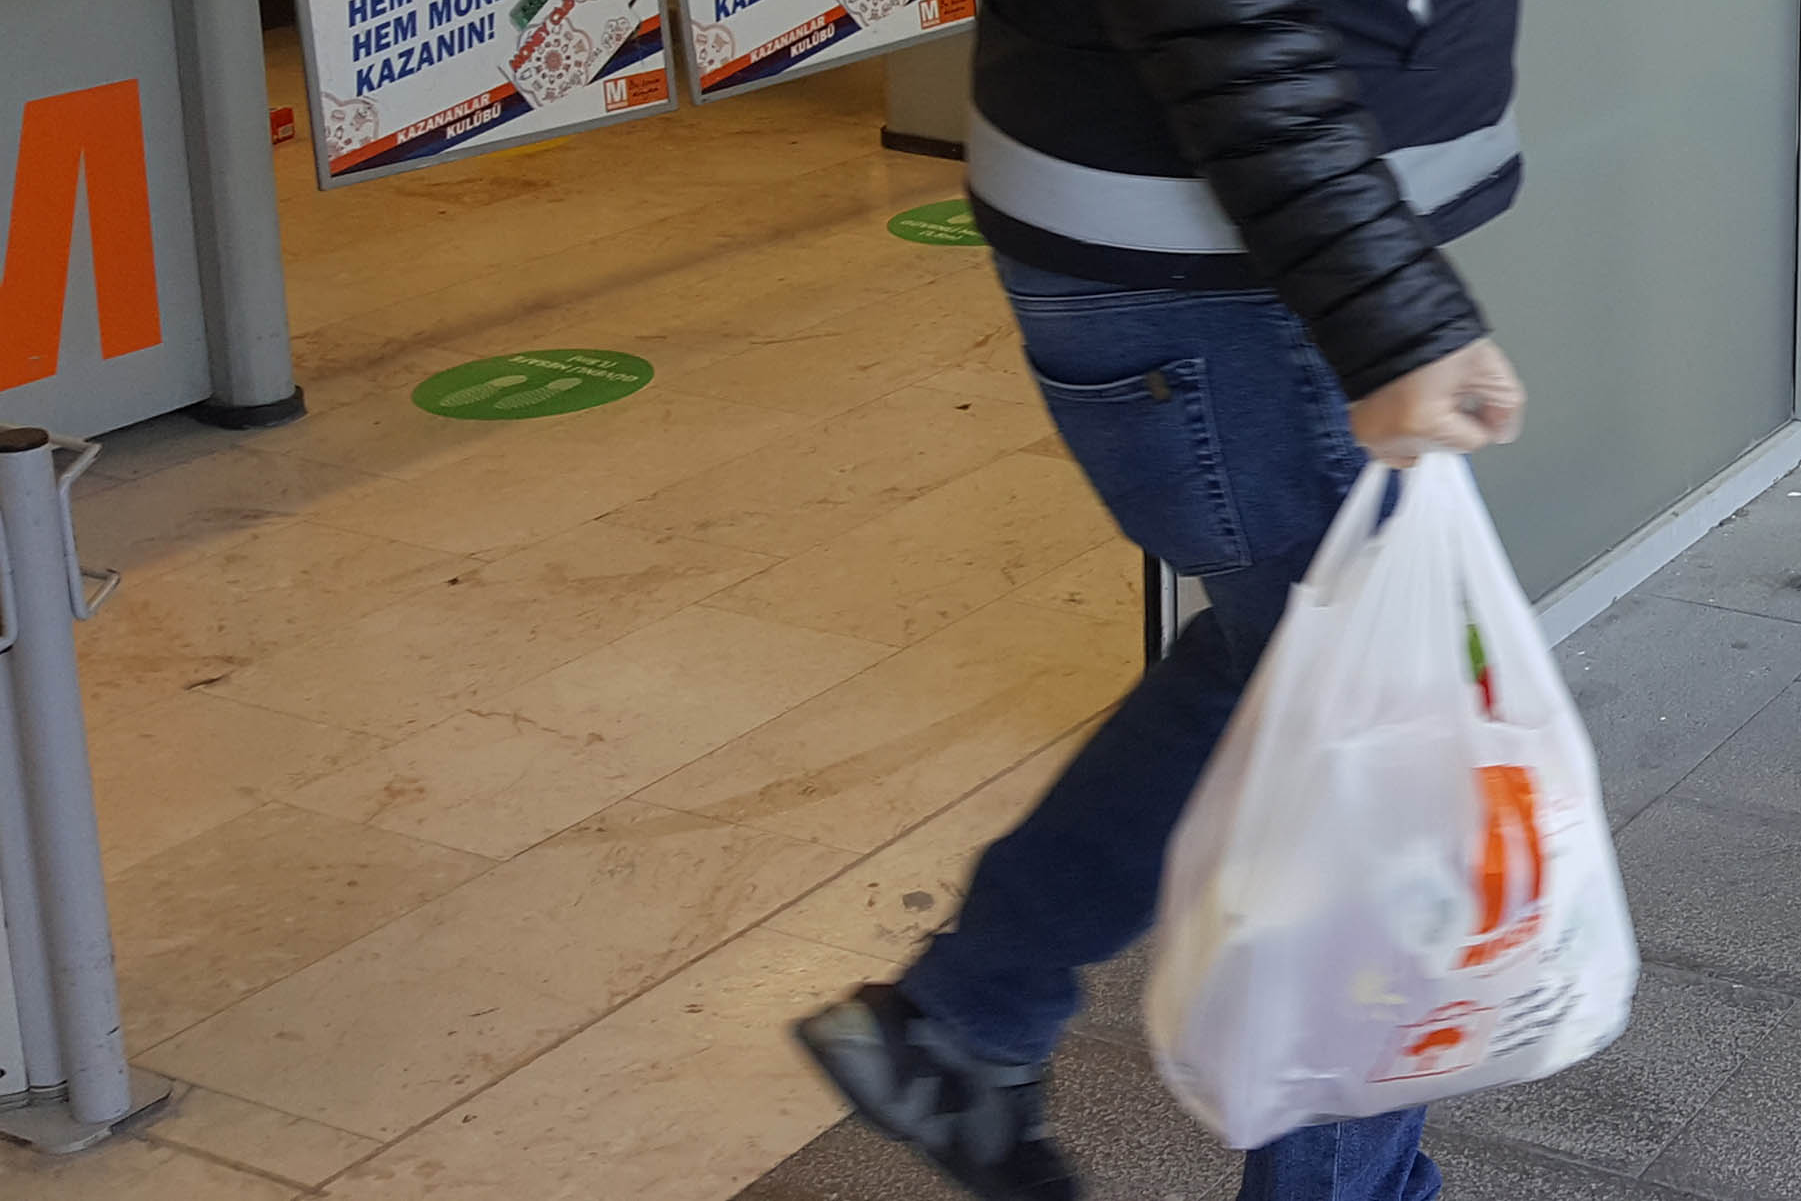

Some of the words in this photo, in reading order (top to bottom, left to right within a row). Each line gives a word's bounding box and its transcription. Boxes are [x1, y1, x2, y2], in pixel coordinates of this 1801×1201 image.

[352, 9, 417, 63] HEM
[356, 11, 496, 98] KAZANIN!
[750, 15, 826, 64] KAZANANLAR
[789, 22, 836, 58] KULÜBÜ
[606, 78, 628, 104] M
[397, 92, 491, 144] KAZANANLAR
[445, 101, 502, 140] KULÜBÜ
